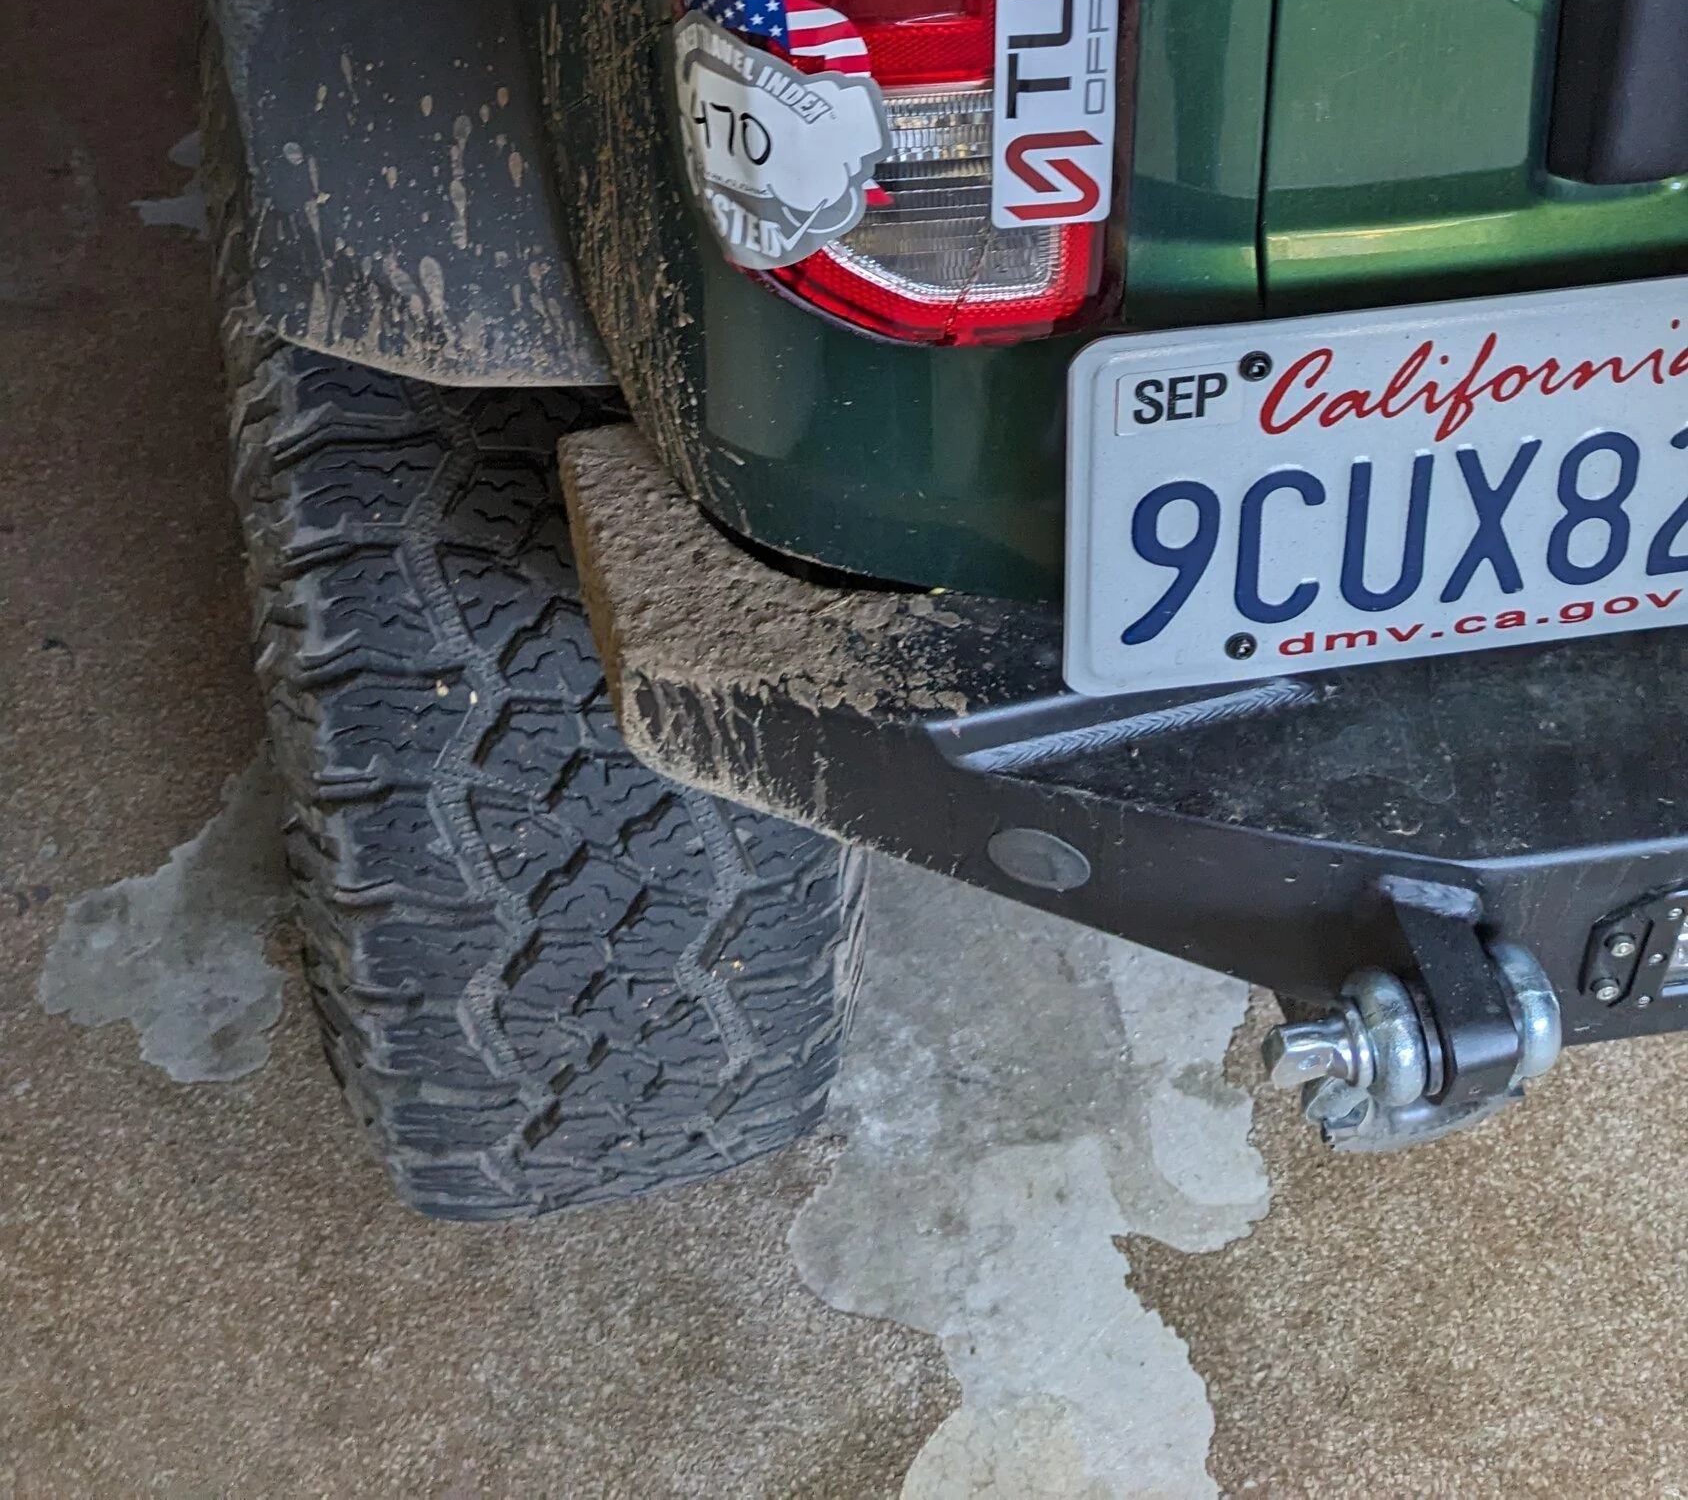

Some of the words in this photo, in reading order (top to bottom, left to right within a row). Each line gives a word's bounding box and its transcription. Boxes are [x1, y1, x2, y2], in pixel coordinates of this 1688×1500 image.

[755, 65, 831, 124] INDEX
[704, 188, 782, 258] STED
[1133, 371, 1228, 425] SEP
[1278, 588, 1683, 657] dmv.ca.gov
